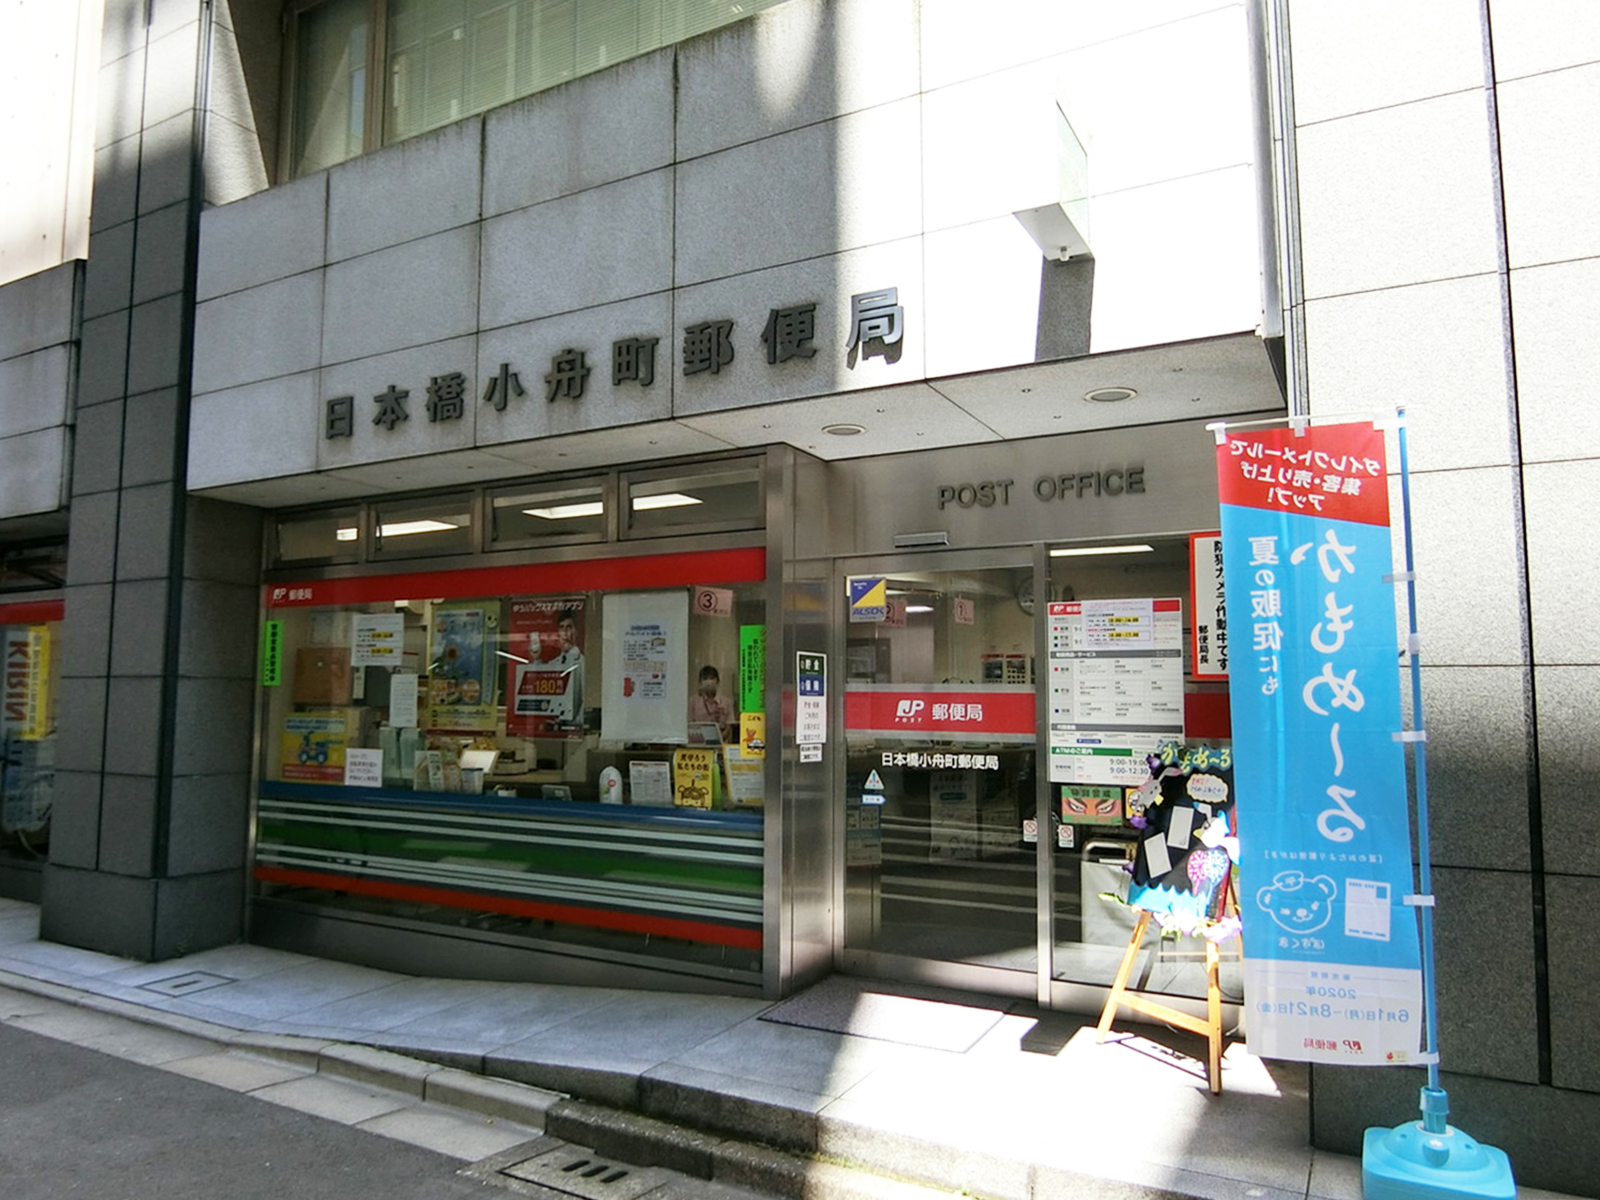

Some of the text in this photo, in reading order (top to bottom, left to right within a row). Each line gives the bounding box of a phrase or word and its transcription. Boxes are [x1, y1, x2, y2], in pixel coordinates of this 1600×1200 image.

[325, 287, 905, 440] 日本橋小舟町郵便局
[937, 467, 1146, 511] POST OFFICE
[289, 588, 313, 601] 郵便局
[852, 606, 885, 616] ALSOK
[1198, 625, 1210, 665] 郵便局長
[534, 680, 556, 694] 180
[932, 704, 983, 722] 郵便局
[881, 752, 999, 770] 日本橋小舟町郵便局
